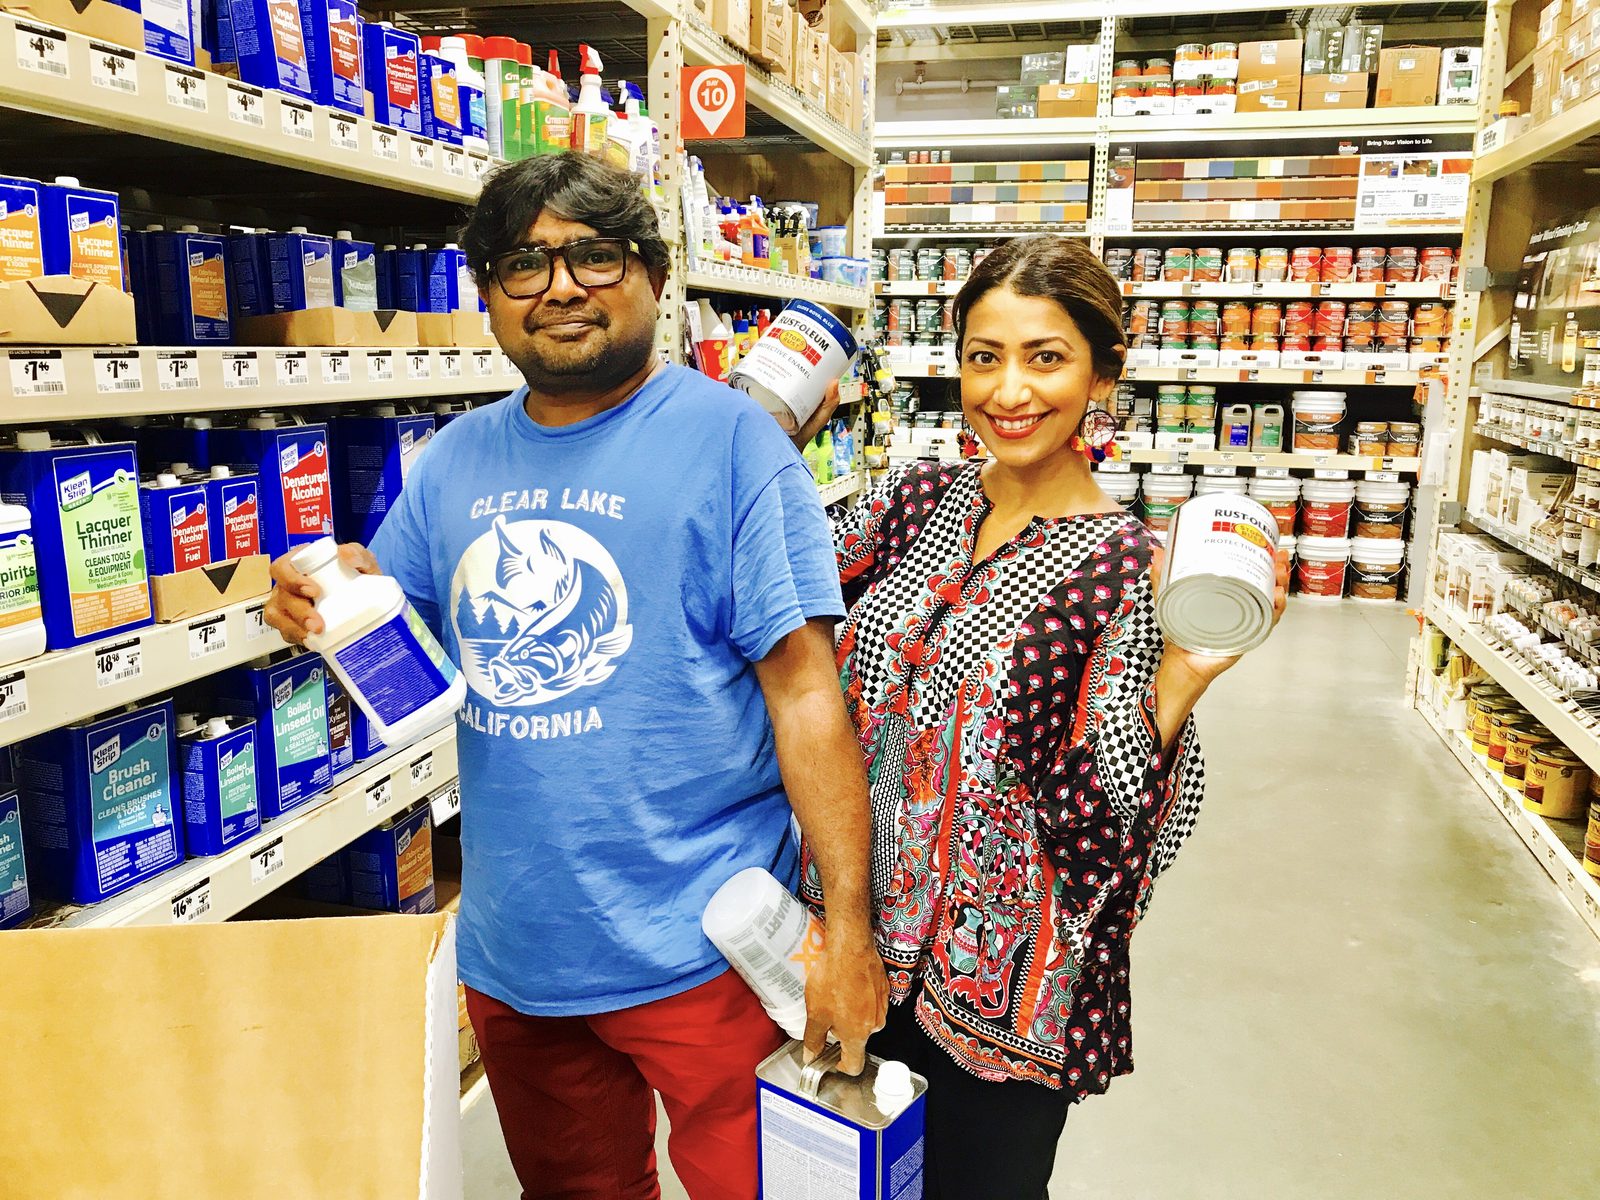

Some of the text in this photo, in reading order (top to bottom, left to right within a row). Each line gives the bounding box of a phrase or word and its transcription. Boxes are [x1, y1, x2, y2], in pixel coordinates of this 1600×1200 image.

[29, 37, 55, 57] $498
[102, 56, 125, 76] $498
[705, 79, 719, 87] BAY
[701, 88, 725, 107] 10
[77, 234, 114, 248] Lacquer
[79, 244, 114, 258] Thinner
[822, 316, 835, 329] BLUE
[783, 337, 800, 349] RUST
[784, 331, 805, 347] STOPS
[24, 361, 50, 381] $746
[107, 360, 129, 379] $746
[169, 360, 188, 378] $728
[787, 356, 812, 380] ENAMEL
[63, 478, 88, 494] Klean
[283, 469, 327, 490] Denatured
[67, 487, 87, 501] Strip
[291, 483, 324, 502] Alcohol
[470, 488, 626, 520] CLEAR LAKE
[75, 515, 132, 536] Lacquer
[225, 510, 258, 526] Denatured
[230, 521, 254, 533] Alcohol
[300, 512, 320, 529] Fuel
[173, 521, 208, 538] Denatured
[78, 530, 133, 551] Thinner
[179, 532, 204, 546] Alcohol
[236, 537, 251, 550] Fuel
[1204, 538, 1257, 554] PROTECTIVE
[84, 550, 131, 568] CLEANS TOOLS
[185, 550, 201, 564] Fuel
[88, 560, 132, 578] & EQUIPMENT
[96, 578, 128, 590] Medium Drying
[100, 574, 118, 583] Lacquer
[0, 583, 40, 600] RIOR JOBS
[199, 626, 217, 645] $728
[97, 653, 120, 674] $1898
[275, 681, 292, 697] Klean
[276, 690, 291, 705] Strip
[287, 698, 312, 719] Boiled
[276, 711, 311, 737] Linseed
[312, 704, 325, 720] Oil
[289, 727, 315, 742] PROTECTS
[289, 736, 306, 750] SEALS
[305, 731, 321, 743] WOOD
[94, 740, 119, 762] Klean
[96, 750, 117, 769] Strip
[108, 758, 150, 785] Brush
[226, 760, 247, 778] Boiled
[102, 770, 158, 802] Cleaner
[220, 770, 245, 789] Linseed
[97, 789, 162, 820] CLEANS BRUSHES
[123, 801, 147, 818] TOOLS
[762, 887, 793, 940] QUART
